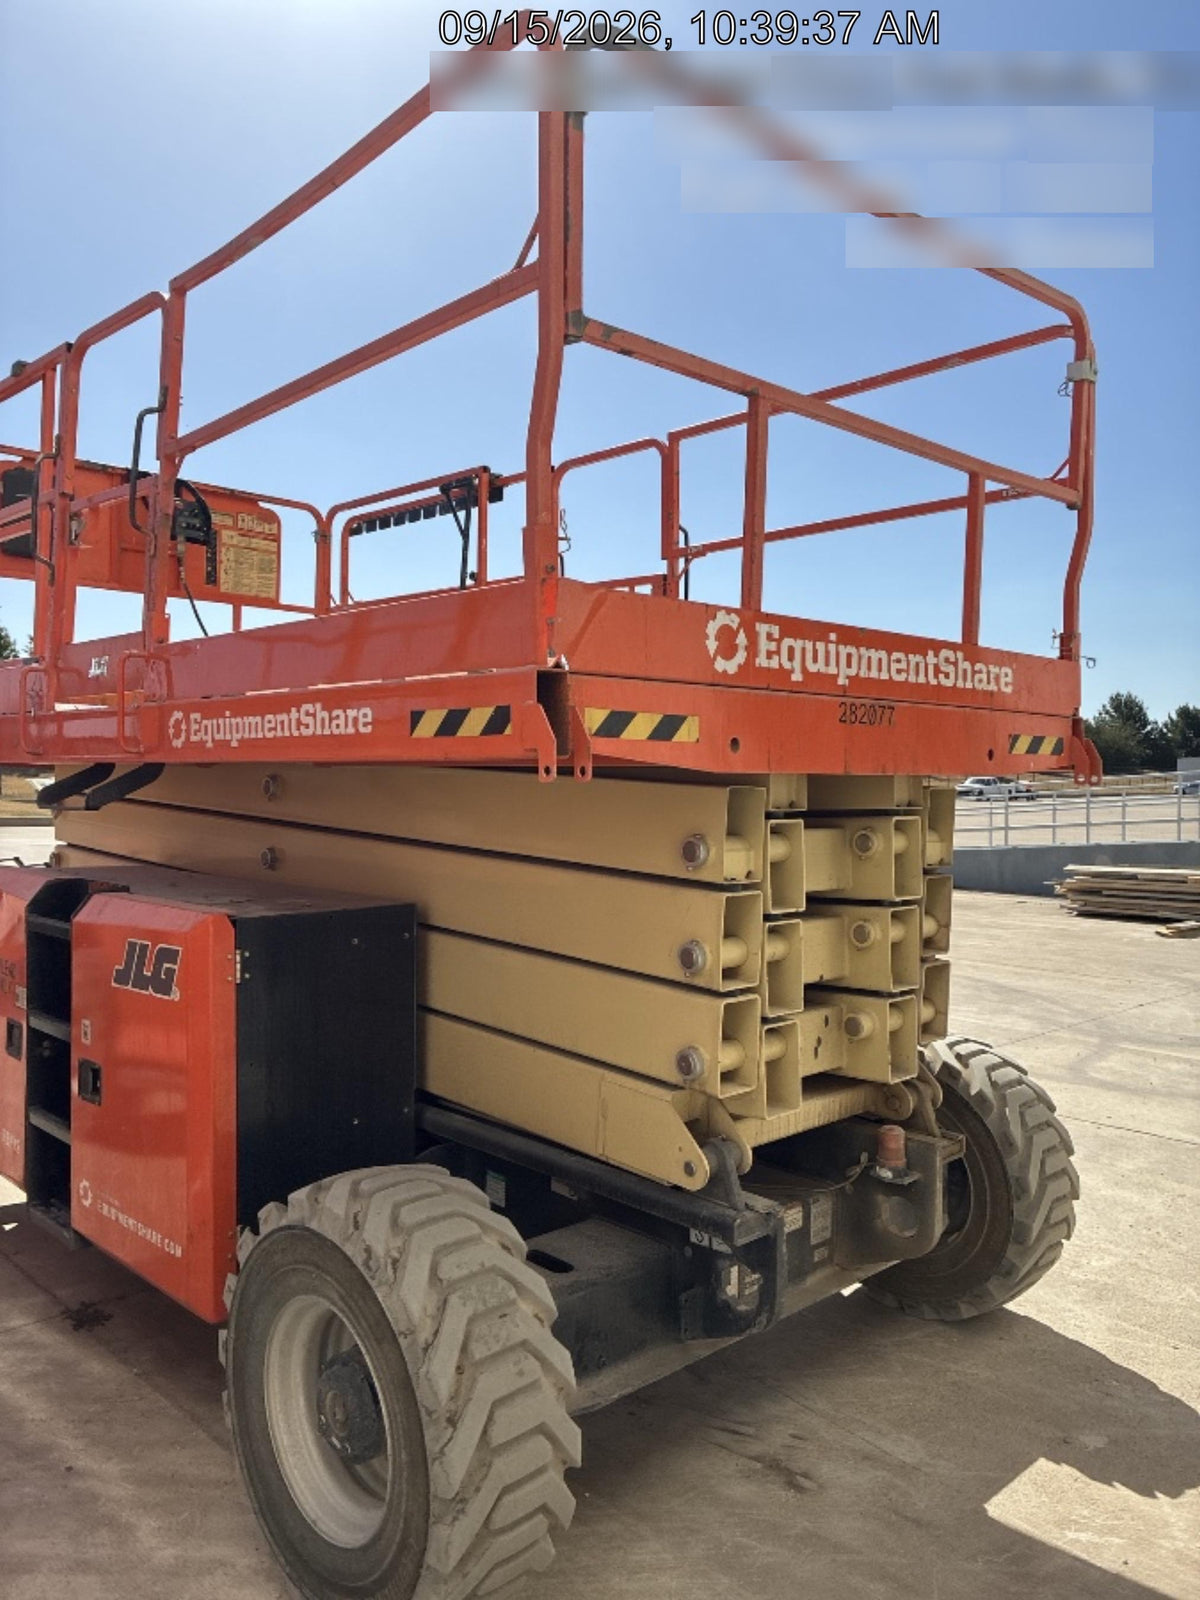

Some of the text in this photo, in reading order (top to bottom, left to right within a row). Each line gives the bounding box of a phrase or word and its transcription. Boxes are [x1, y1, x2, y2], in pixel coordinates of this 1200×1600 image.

[755, 621, 1014, 693] EquipmentShare
[189, 702, 373, 748] EquipmentShare
[838, 701, 896, 726] 282077
